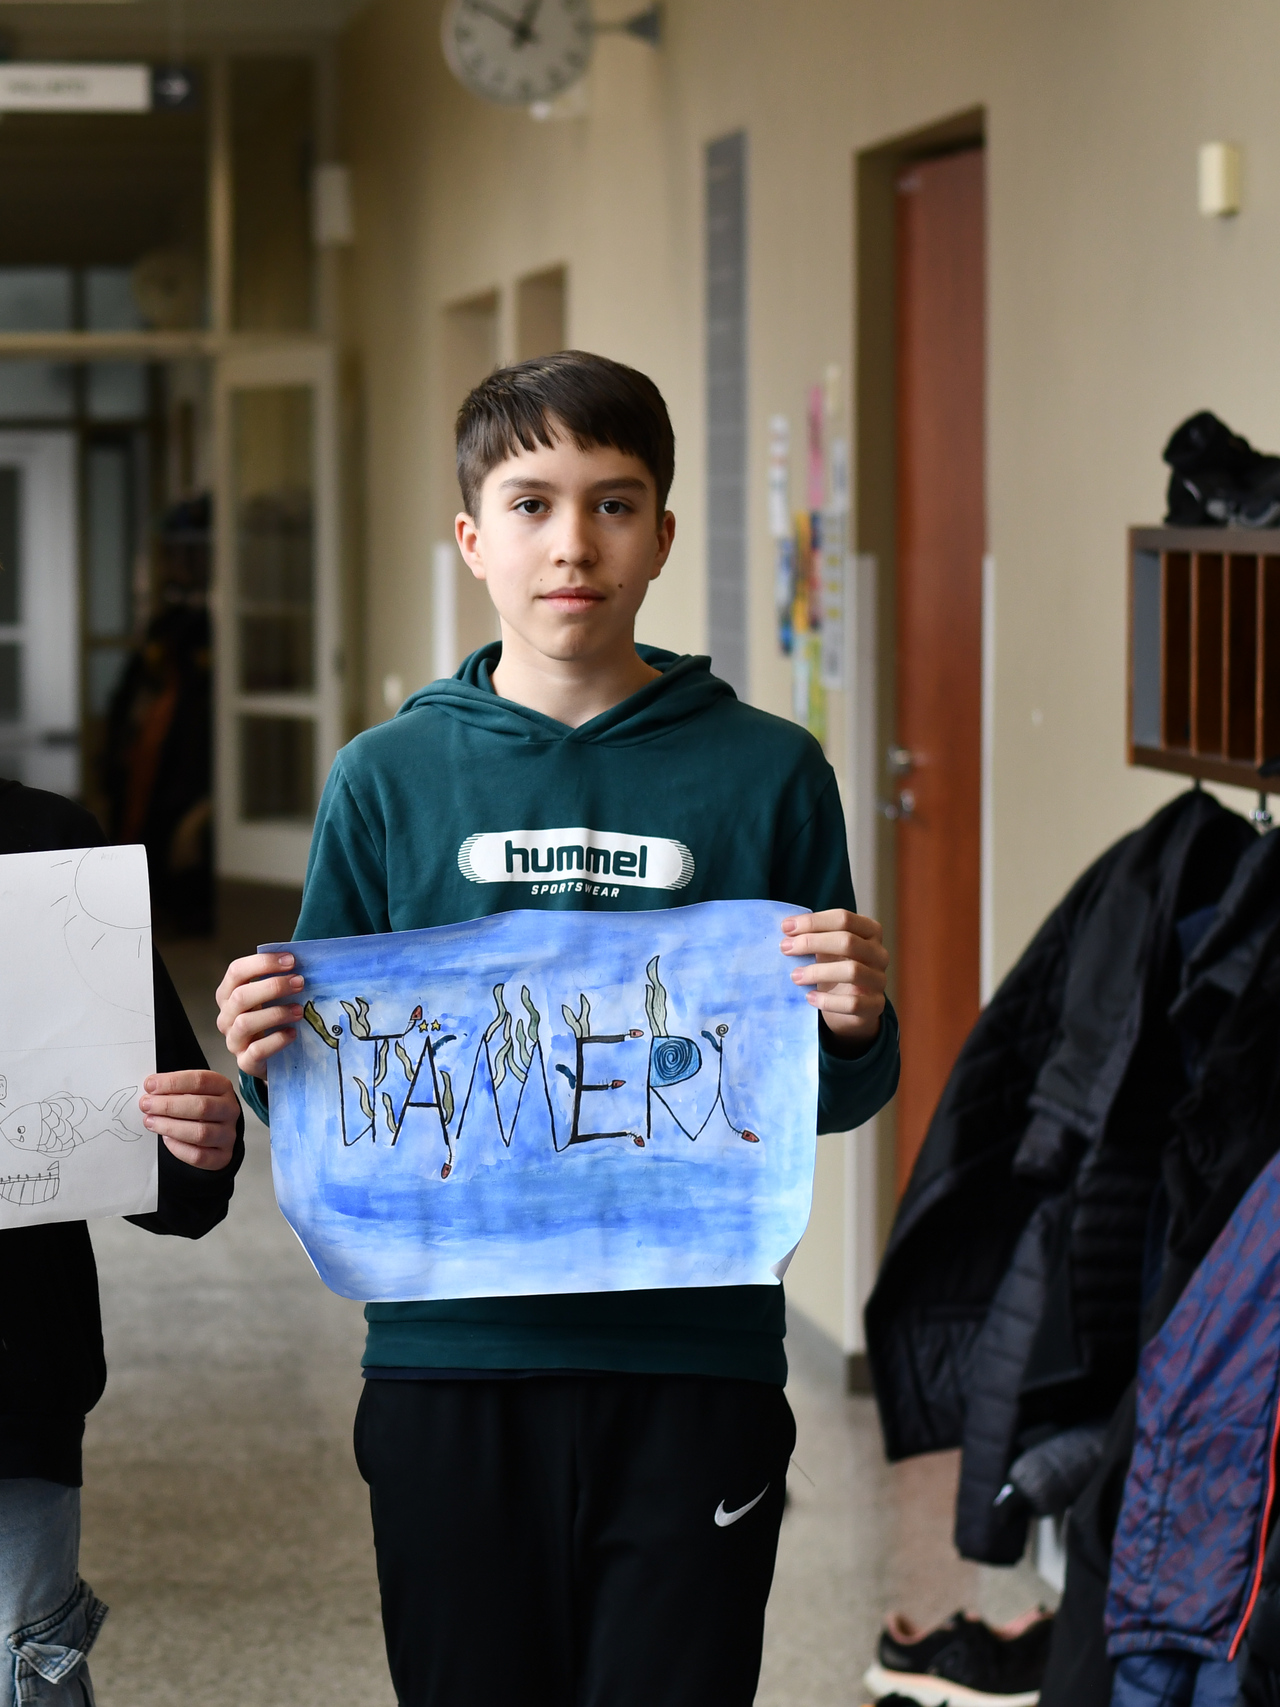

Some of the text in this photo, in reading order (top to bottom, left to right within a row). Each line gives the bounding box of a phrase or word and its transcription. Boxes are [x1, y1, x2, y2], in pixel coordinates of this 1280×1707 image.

[504, 839, 648, 879] hummel
[530, 881, 621, 898] SPORTSWEAR
[325, 1008, 758, 1158] ITÄMERI
